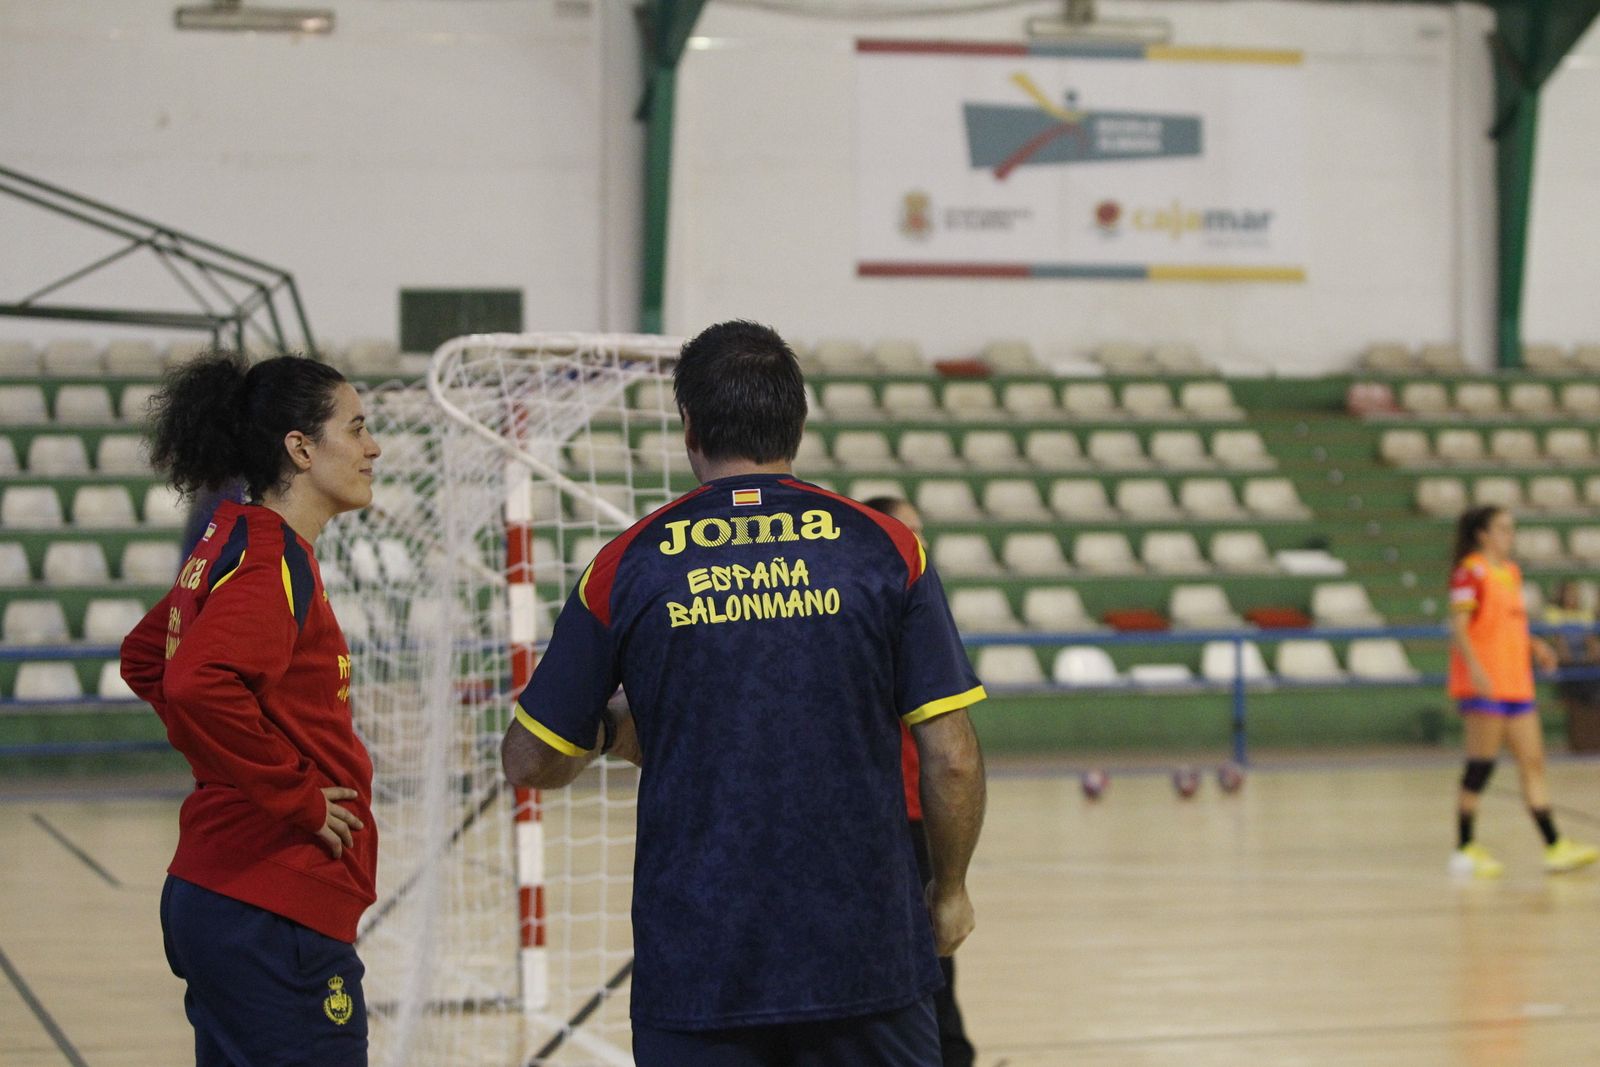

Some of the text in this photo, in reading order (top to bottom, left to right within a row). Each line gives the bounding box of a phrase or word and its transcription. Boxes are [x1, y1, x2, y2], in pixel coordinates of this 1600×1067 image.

[1132, 202, 1275, 241] cajamar
[659, 508, 841, 556] Joma
[686, 556, 810, 595] ESPAÑA
[665, 587, 841, 628] BALONMANO
